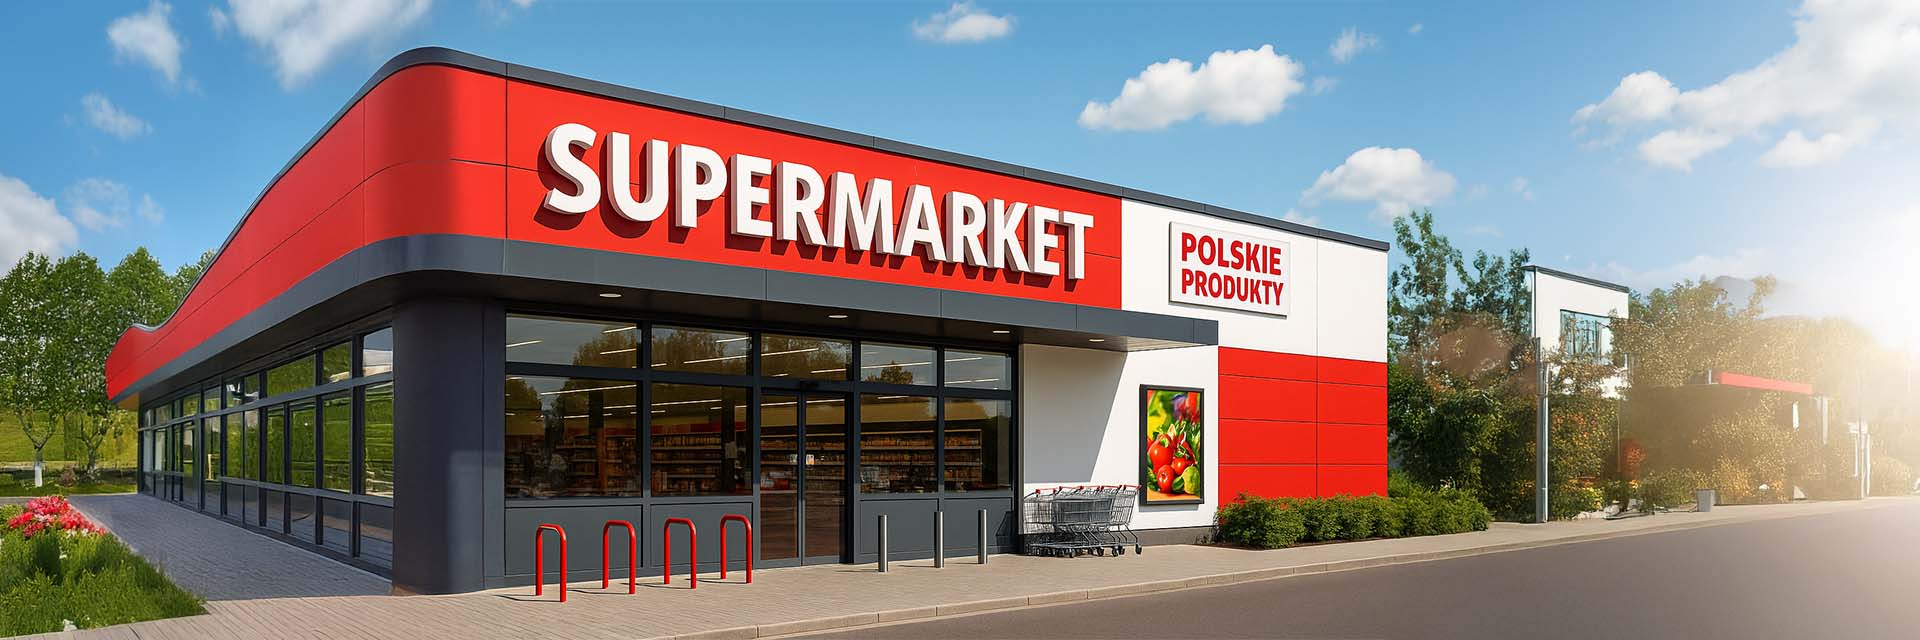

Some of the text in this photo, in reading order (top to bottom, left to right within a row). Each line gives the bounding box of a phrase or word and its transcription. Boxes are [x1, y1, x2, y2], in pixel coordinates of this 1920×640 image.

[543, 122, 1095, 280] SUPERMARKET
[1181, 231, 1282, 276] POLSKIE
[1181, 268, 1284, 306] PRODUKTY
